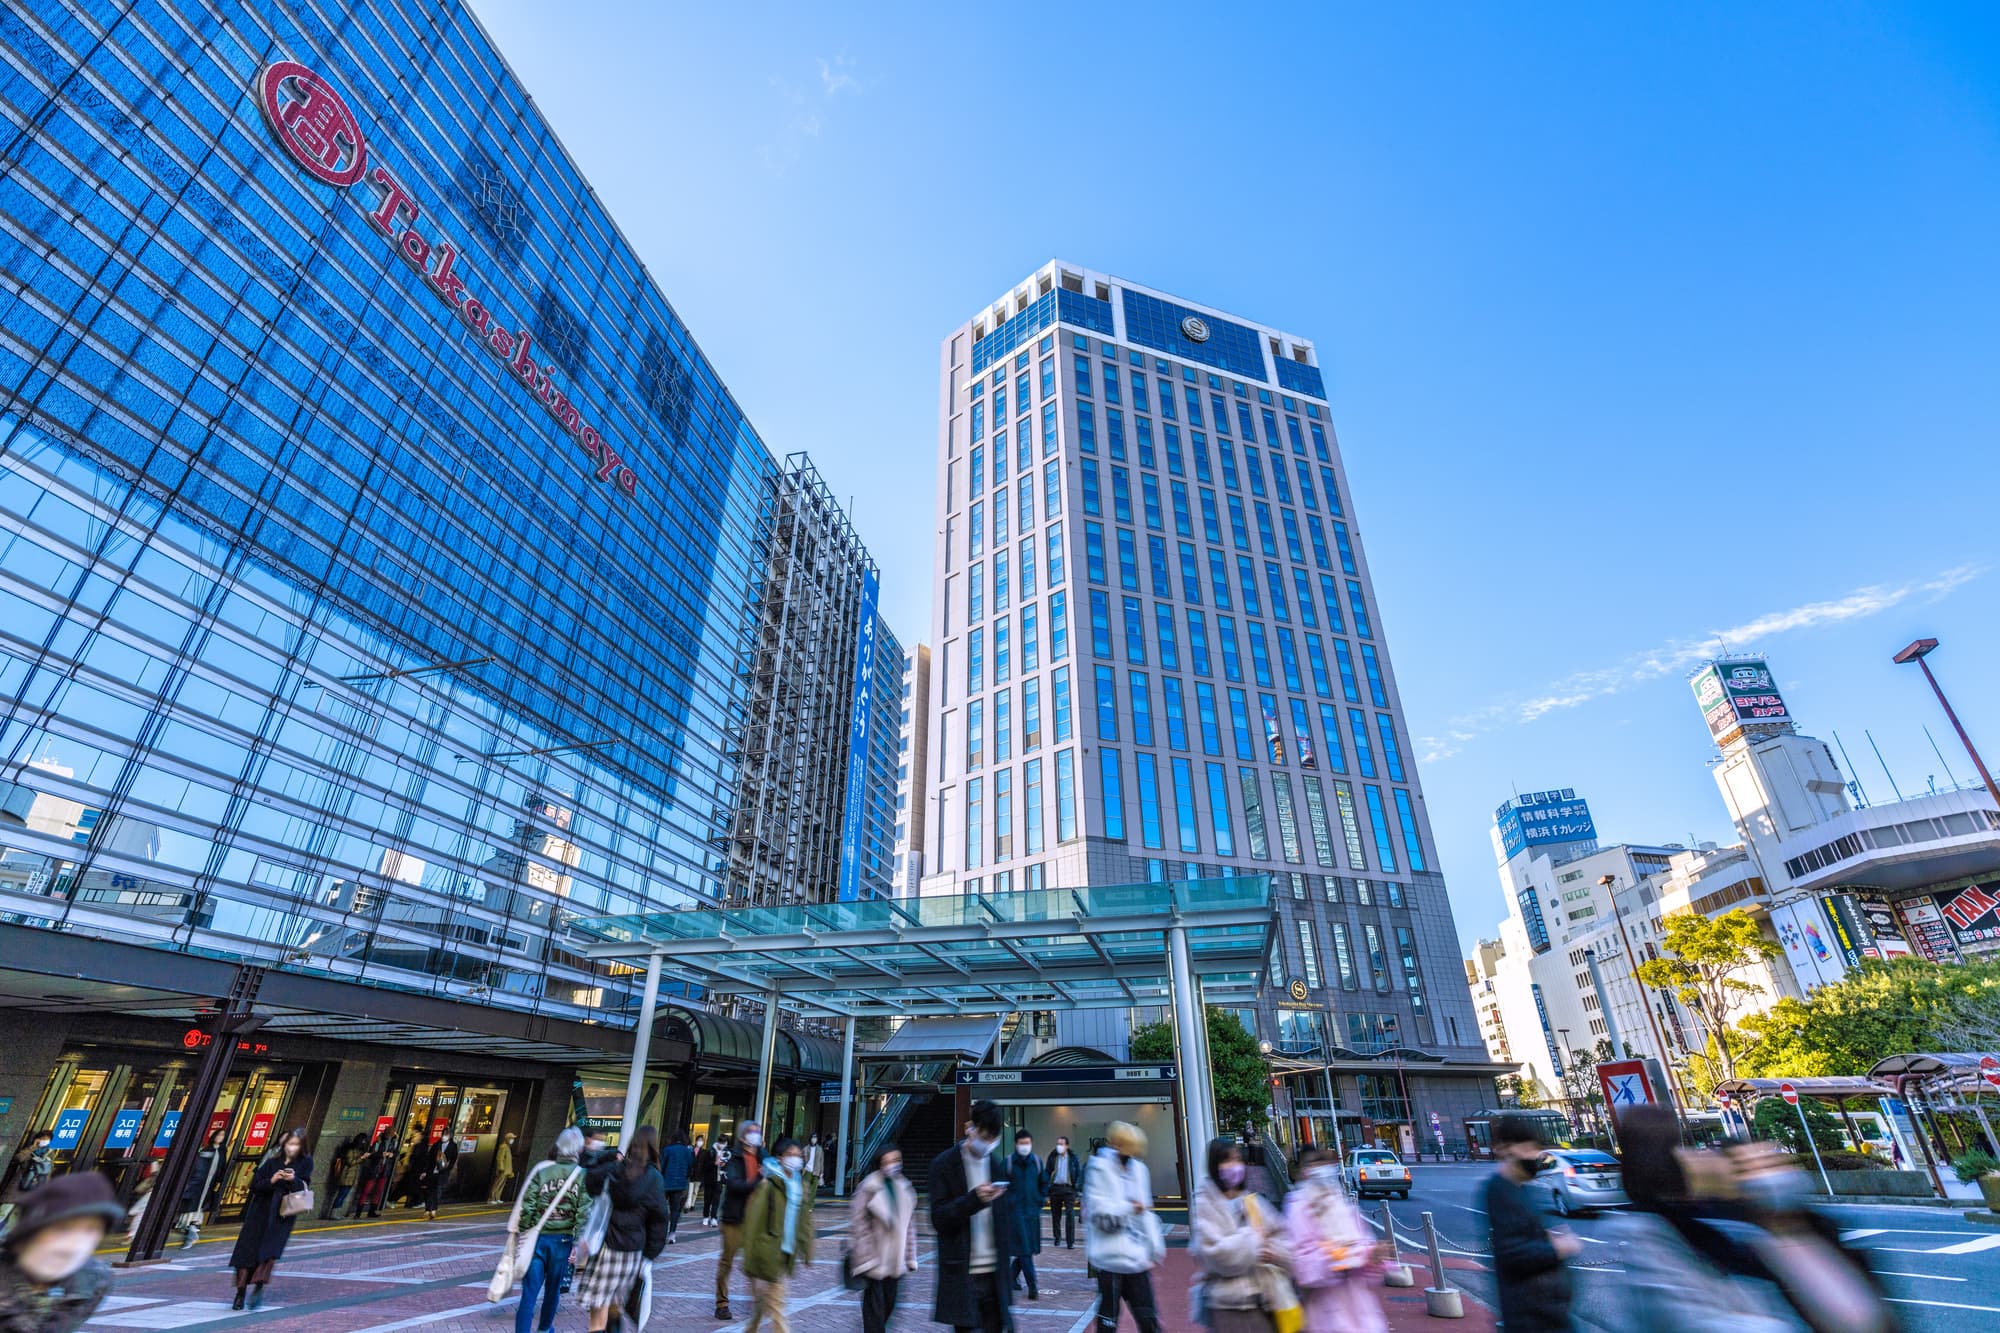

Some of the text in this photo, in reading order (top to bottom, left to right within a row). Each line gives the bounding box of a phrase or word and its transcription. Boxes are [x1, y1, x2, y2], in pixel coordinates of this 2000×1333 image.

[368, 167, 638, 497] Takashimaya
[1734, 695, 1781, 708] ヨドバシ
[1752, 706, 1785, 718] カメラ
[1941, 885, 2000, 930] TAX
[416, 1096, 432, 1105] STA
[62, 1119, 81, 1128] 入口
[118, 1119, 136, 1128] 入口
[254, 1121, 268, 1129] 出口
[58, 1129, 76, 1138] 専用
[114, 1129, 131, 1138] 専用
[541, 1179, 578, 1198] ALPA
